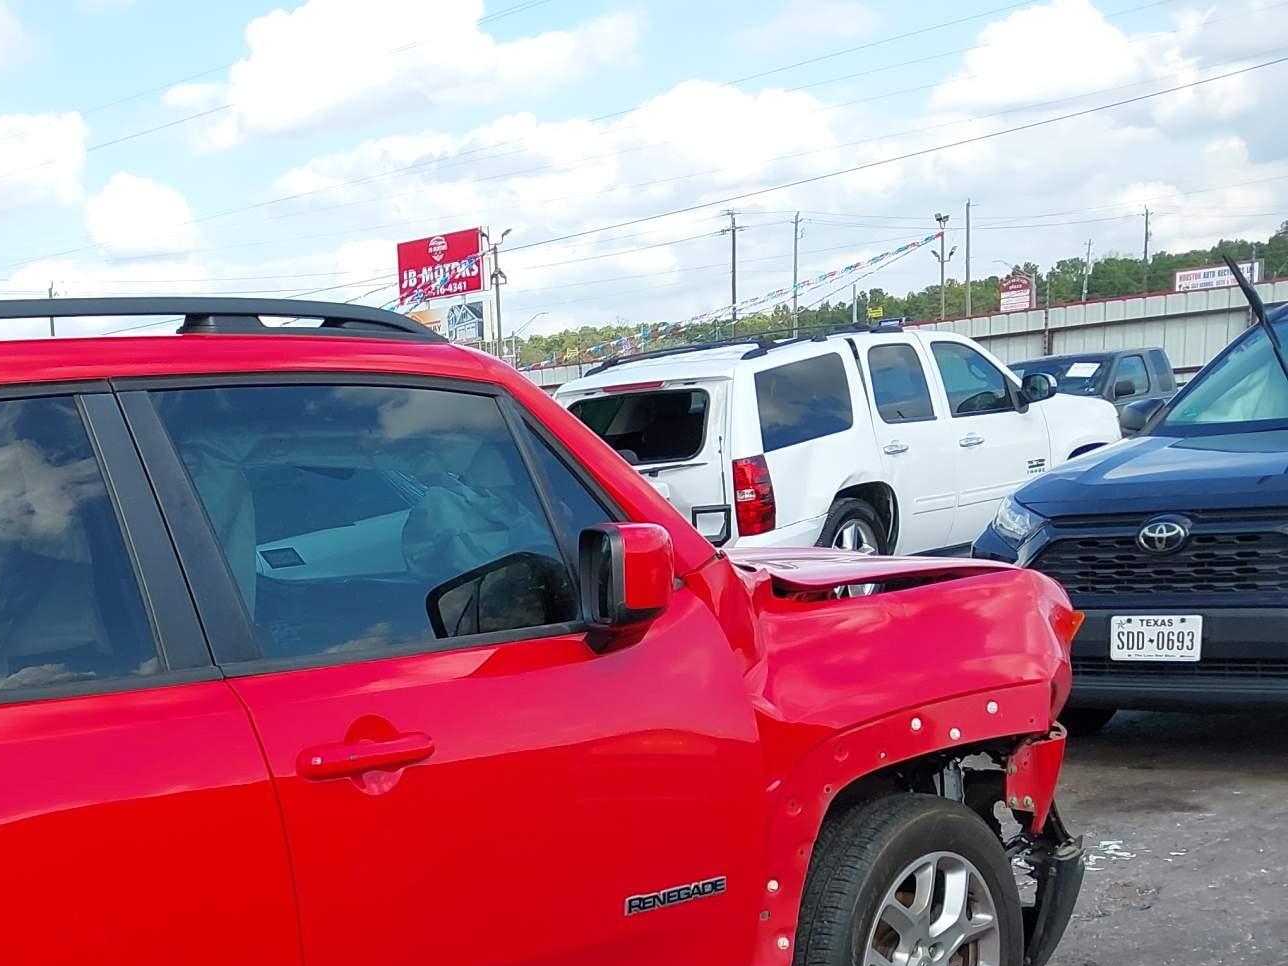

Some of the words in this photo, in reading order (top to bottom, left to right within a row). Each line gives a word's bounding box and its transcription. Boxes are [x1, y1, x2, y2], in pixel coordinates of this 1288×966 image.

[402, 269, 417, 289] JB
[1139, 618, 1174, 627] TEXAS
[1117, 631, 1145, 650] SDD
[1156, 631, 1195, 650] 0693
[624, 876, 726, 916] RENEGADE
